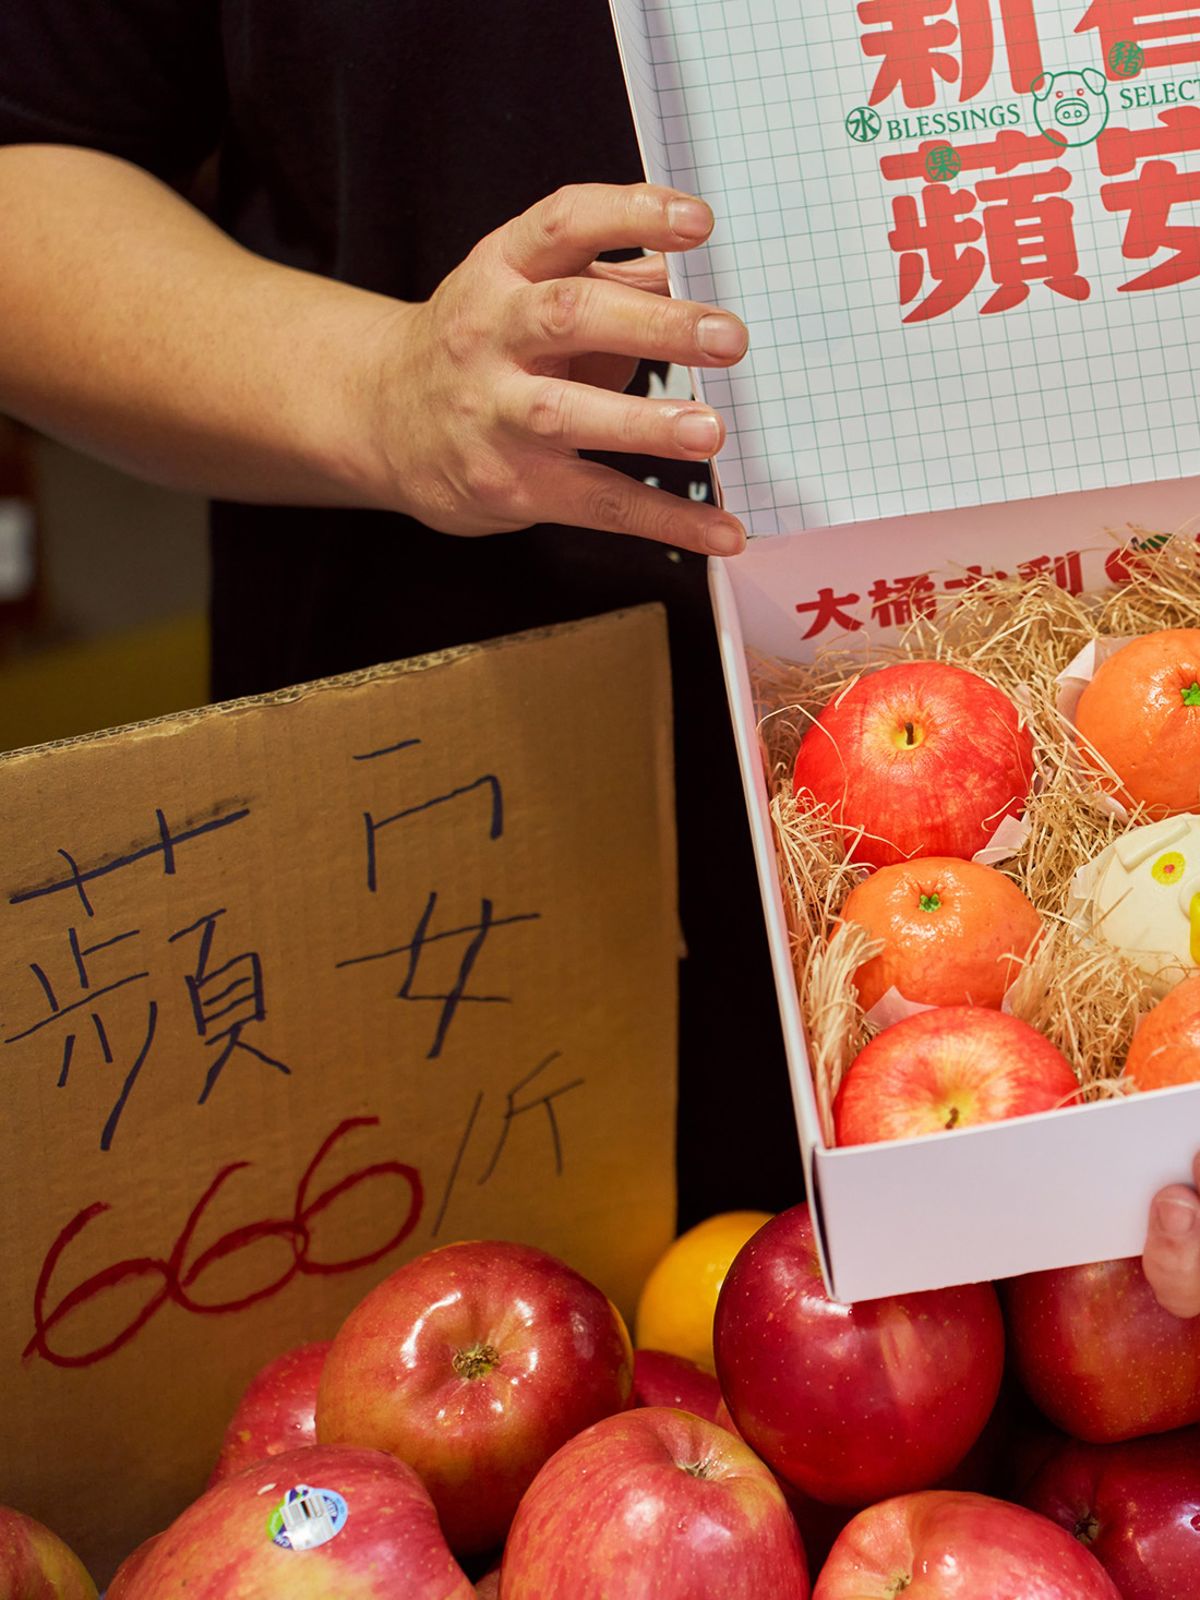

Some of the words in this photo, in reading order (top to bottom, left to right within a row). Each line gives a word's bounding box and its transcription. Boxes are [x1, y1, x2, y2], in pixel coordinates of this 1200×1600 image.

[846, 107, 881, 142] 水
[887, 103, 1021, 141] BLESSINGS
[926, 147, 961, 181] 果
